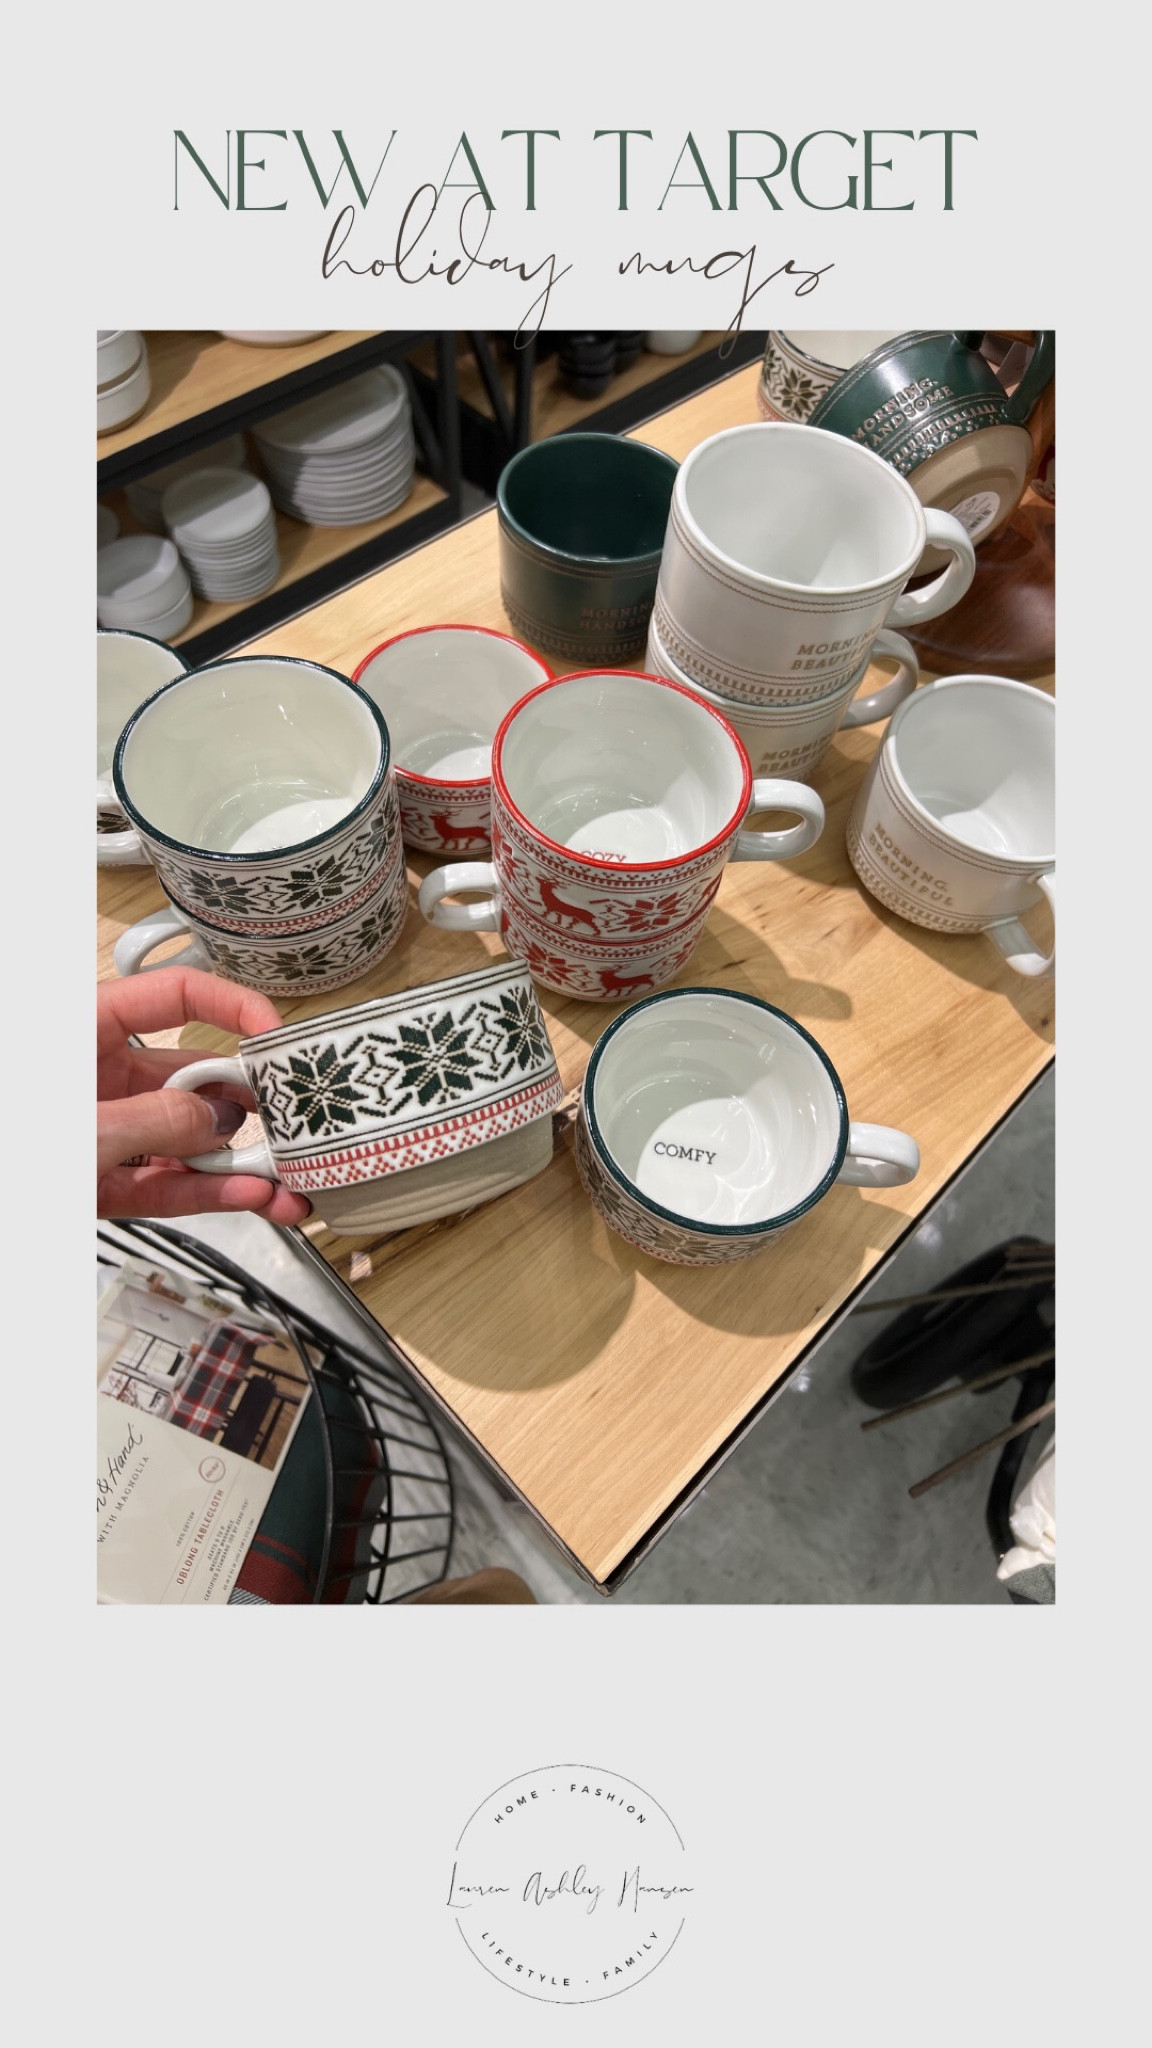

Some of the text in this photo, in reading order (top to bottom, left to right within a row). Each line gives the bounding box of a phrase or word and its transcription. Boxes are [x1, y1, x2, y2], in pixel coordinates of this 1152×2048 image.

[868, 833, 954, 907] BEAUTIFUL
[654, 1141, 717, 1165] COMFY
[107, 1422, 143, 1486] Hand
[97, 1456, 149, 1543] WITH MAGNOLIA
[176, 1547, 199, 1585] OBLONG
[194, 1489, 225, 1544] TABLECLOTH
